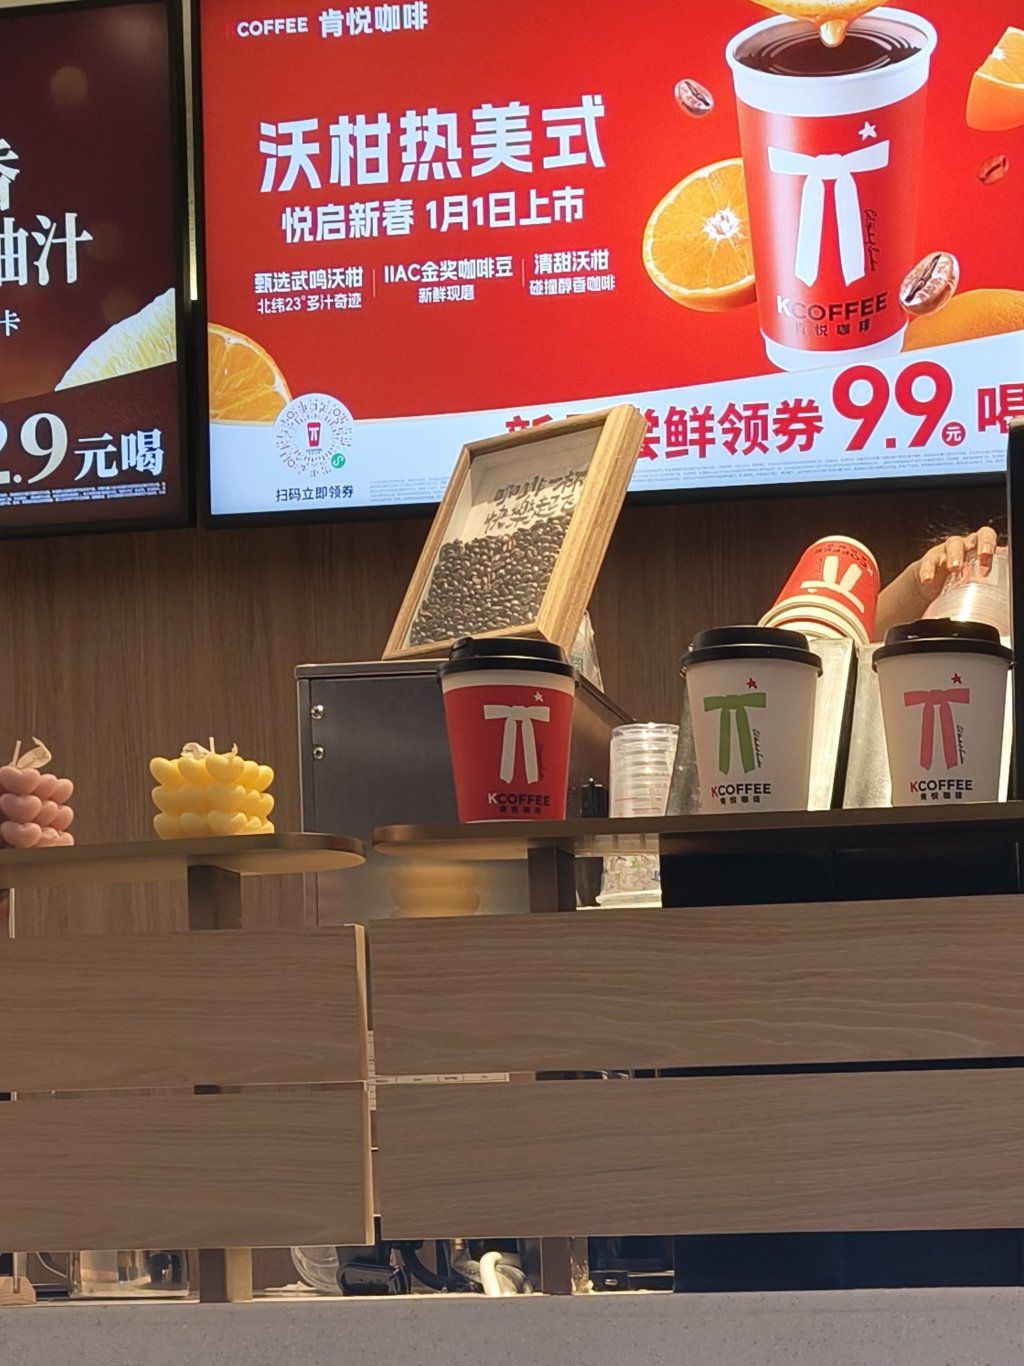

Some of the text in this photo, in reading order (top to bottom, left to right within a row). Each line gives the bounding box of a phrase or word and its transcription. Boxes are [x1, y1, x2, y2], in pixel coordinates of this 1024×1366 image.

[319, 1, 428, 38] 肯悦咖啡
[259, 94, 606, 193] 沃柑热美式
[282, 186, 585, 243] 悦启新春 1月1日上市
[534, 248, 609, 274] 清甜沃柑
[254, 267, 364, 294] 甄选武鸣沃柑
[776, 291, 888, 321] KCOFFEE
[831, 361, 953, 451] 9.9
[74, 428, 164, 481] 元喝
[275, 485, 354, 502] 扫码立即领券
[487, 793, 551, 807] KCOFFEE
[711, 783, 772, 798] KCOFFEE
[910, 779, 973, 793] KCOFFEE
